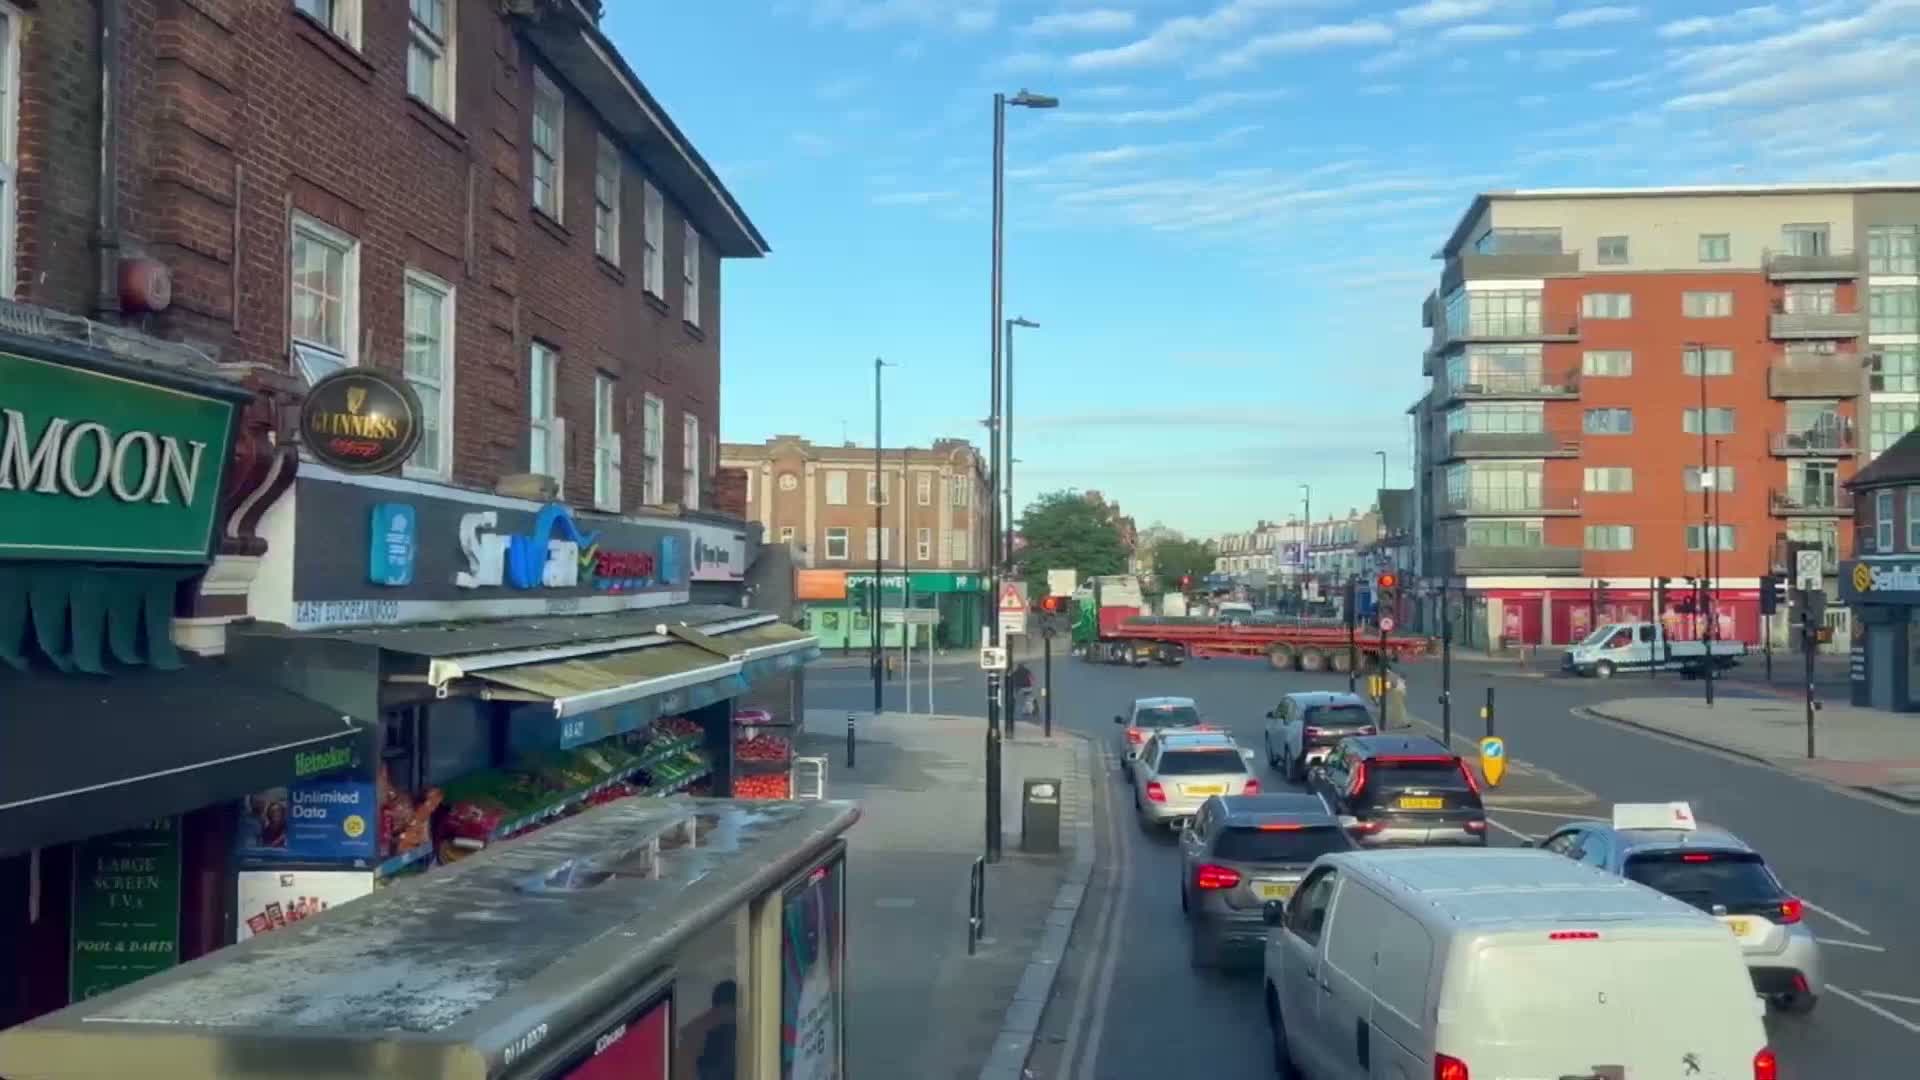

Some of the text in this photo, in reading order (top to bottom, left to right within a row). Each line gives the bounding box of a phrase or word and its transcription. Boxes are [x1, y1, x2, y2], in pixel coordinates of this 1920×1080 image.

[311, 411, 398, 439] GUINNESS
[0, 408, 207, 508] MOON
[292, 789, 360, 804] Unlimited
[292, 804, 328, 818] Data
[97, 857, 157, 873] LARGE
[94, 875, 160, 890] SCREEN
[77, 940, 110, 953] POOL
[129, 940, 174, 953] DARTS
